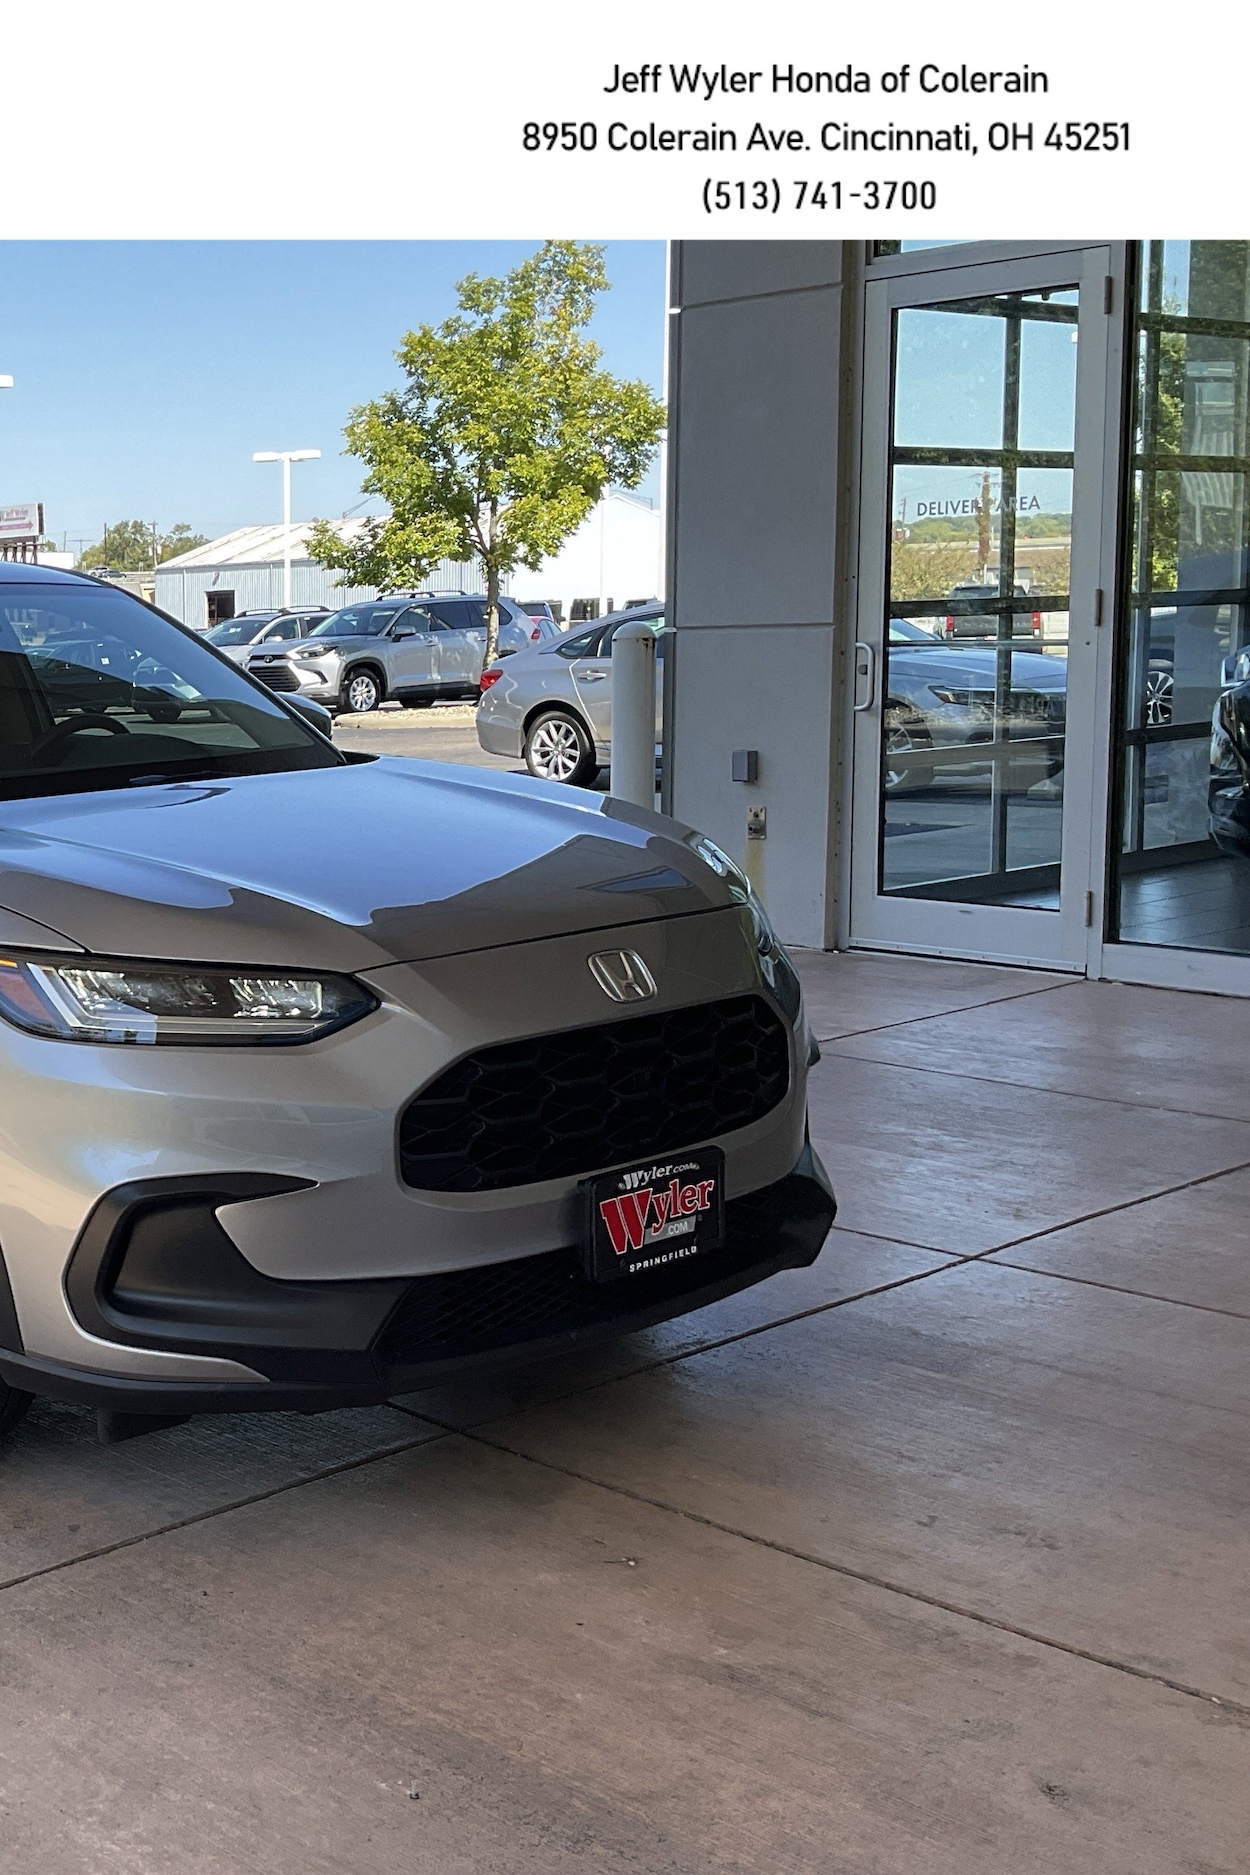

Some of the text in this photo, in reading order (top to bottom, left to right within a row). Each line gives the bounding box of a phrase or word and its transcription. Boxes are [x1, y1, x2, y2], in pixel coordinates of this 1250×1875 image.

[996, 495, 1040, 512] AREA
[600, 1178, 715, 1255] Wyler
[629, 1246, 697, 1272] SPRINGFIELD
